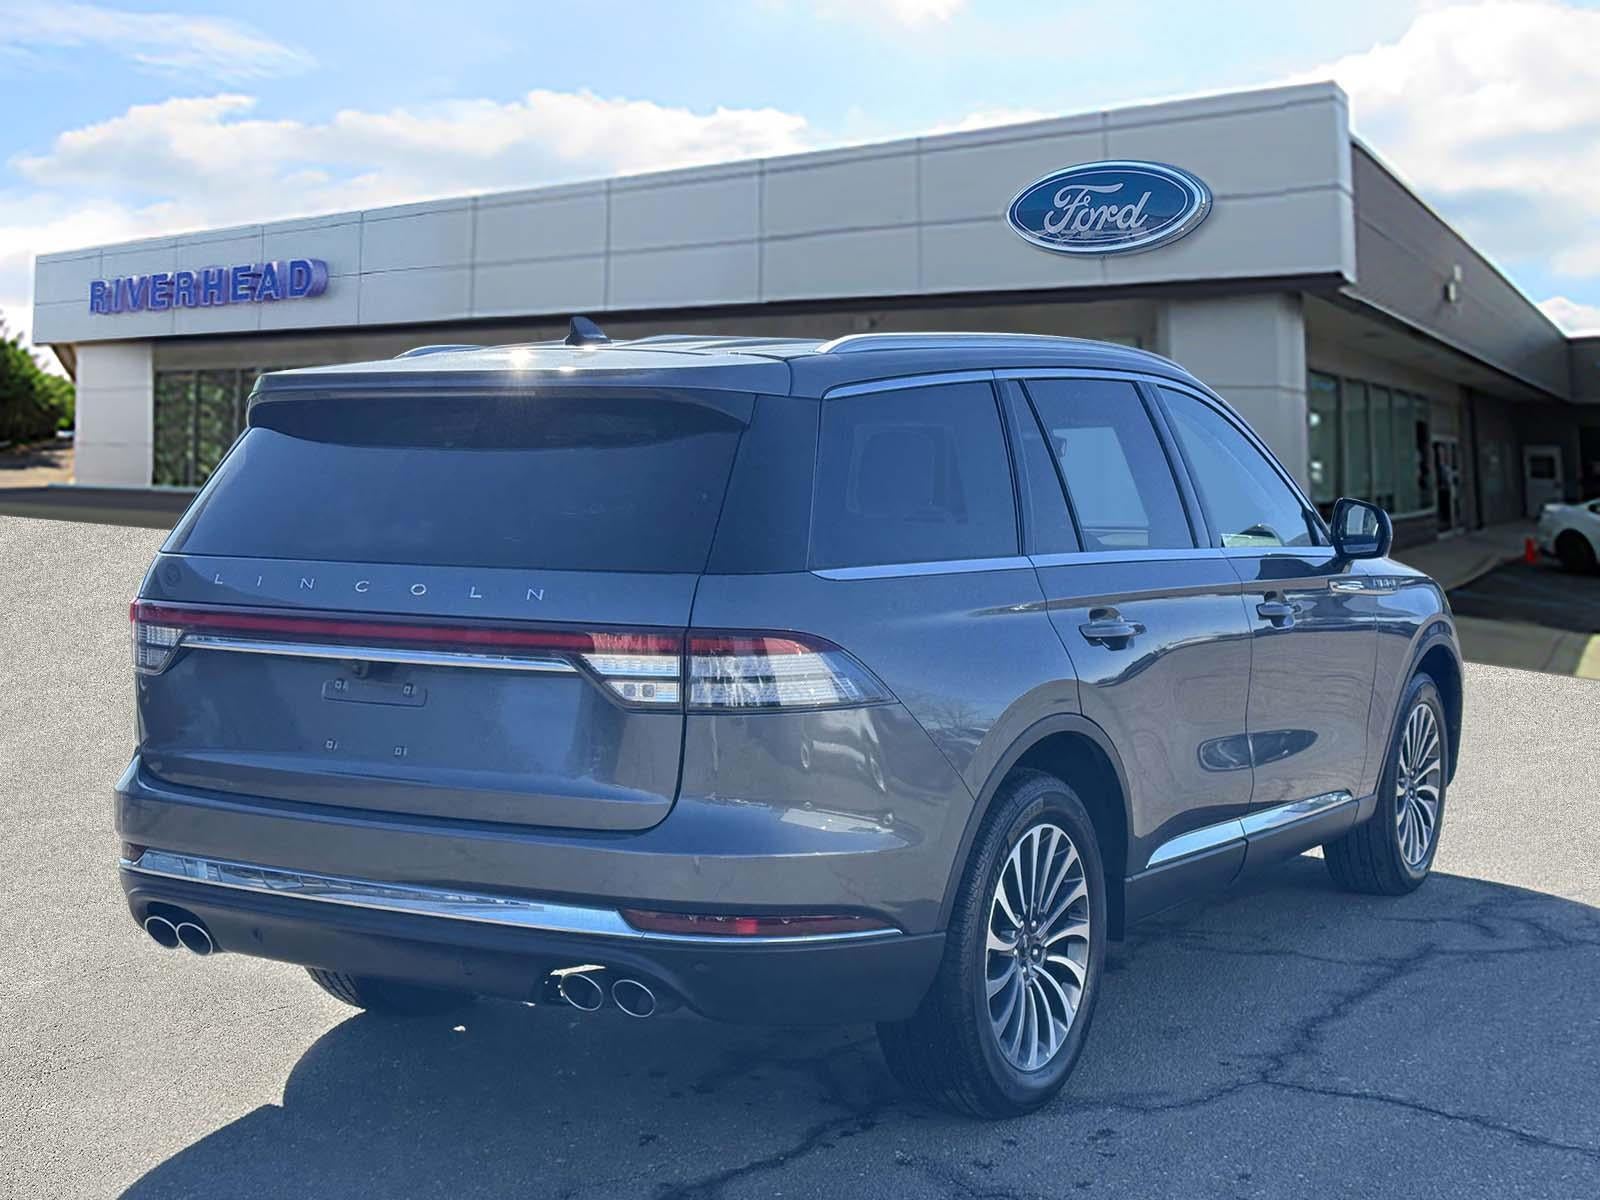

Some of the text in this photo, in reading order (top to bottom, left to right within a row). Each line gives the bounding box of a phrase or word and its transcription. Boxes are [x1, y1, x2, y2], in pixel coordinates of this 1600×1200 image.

[1043, 182, 1152, 234] Ford
[90, 258, 327, 313] RIVERHEAD
[213, 573, 545, 601] LINCOLN
